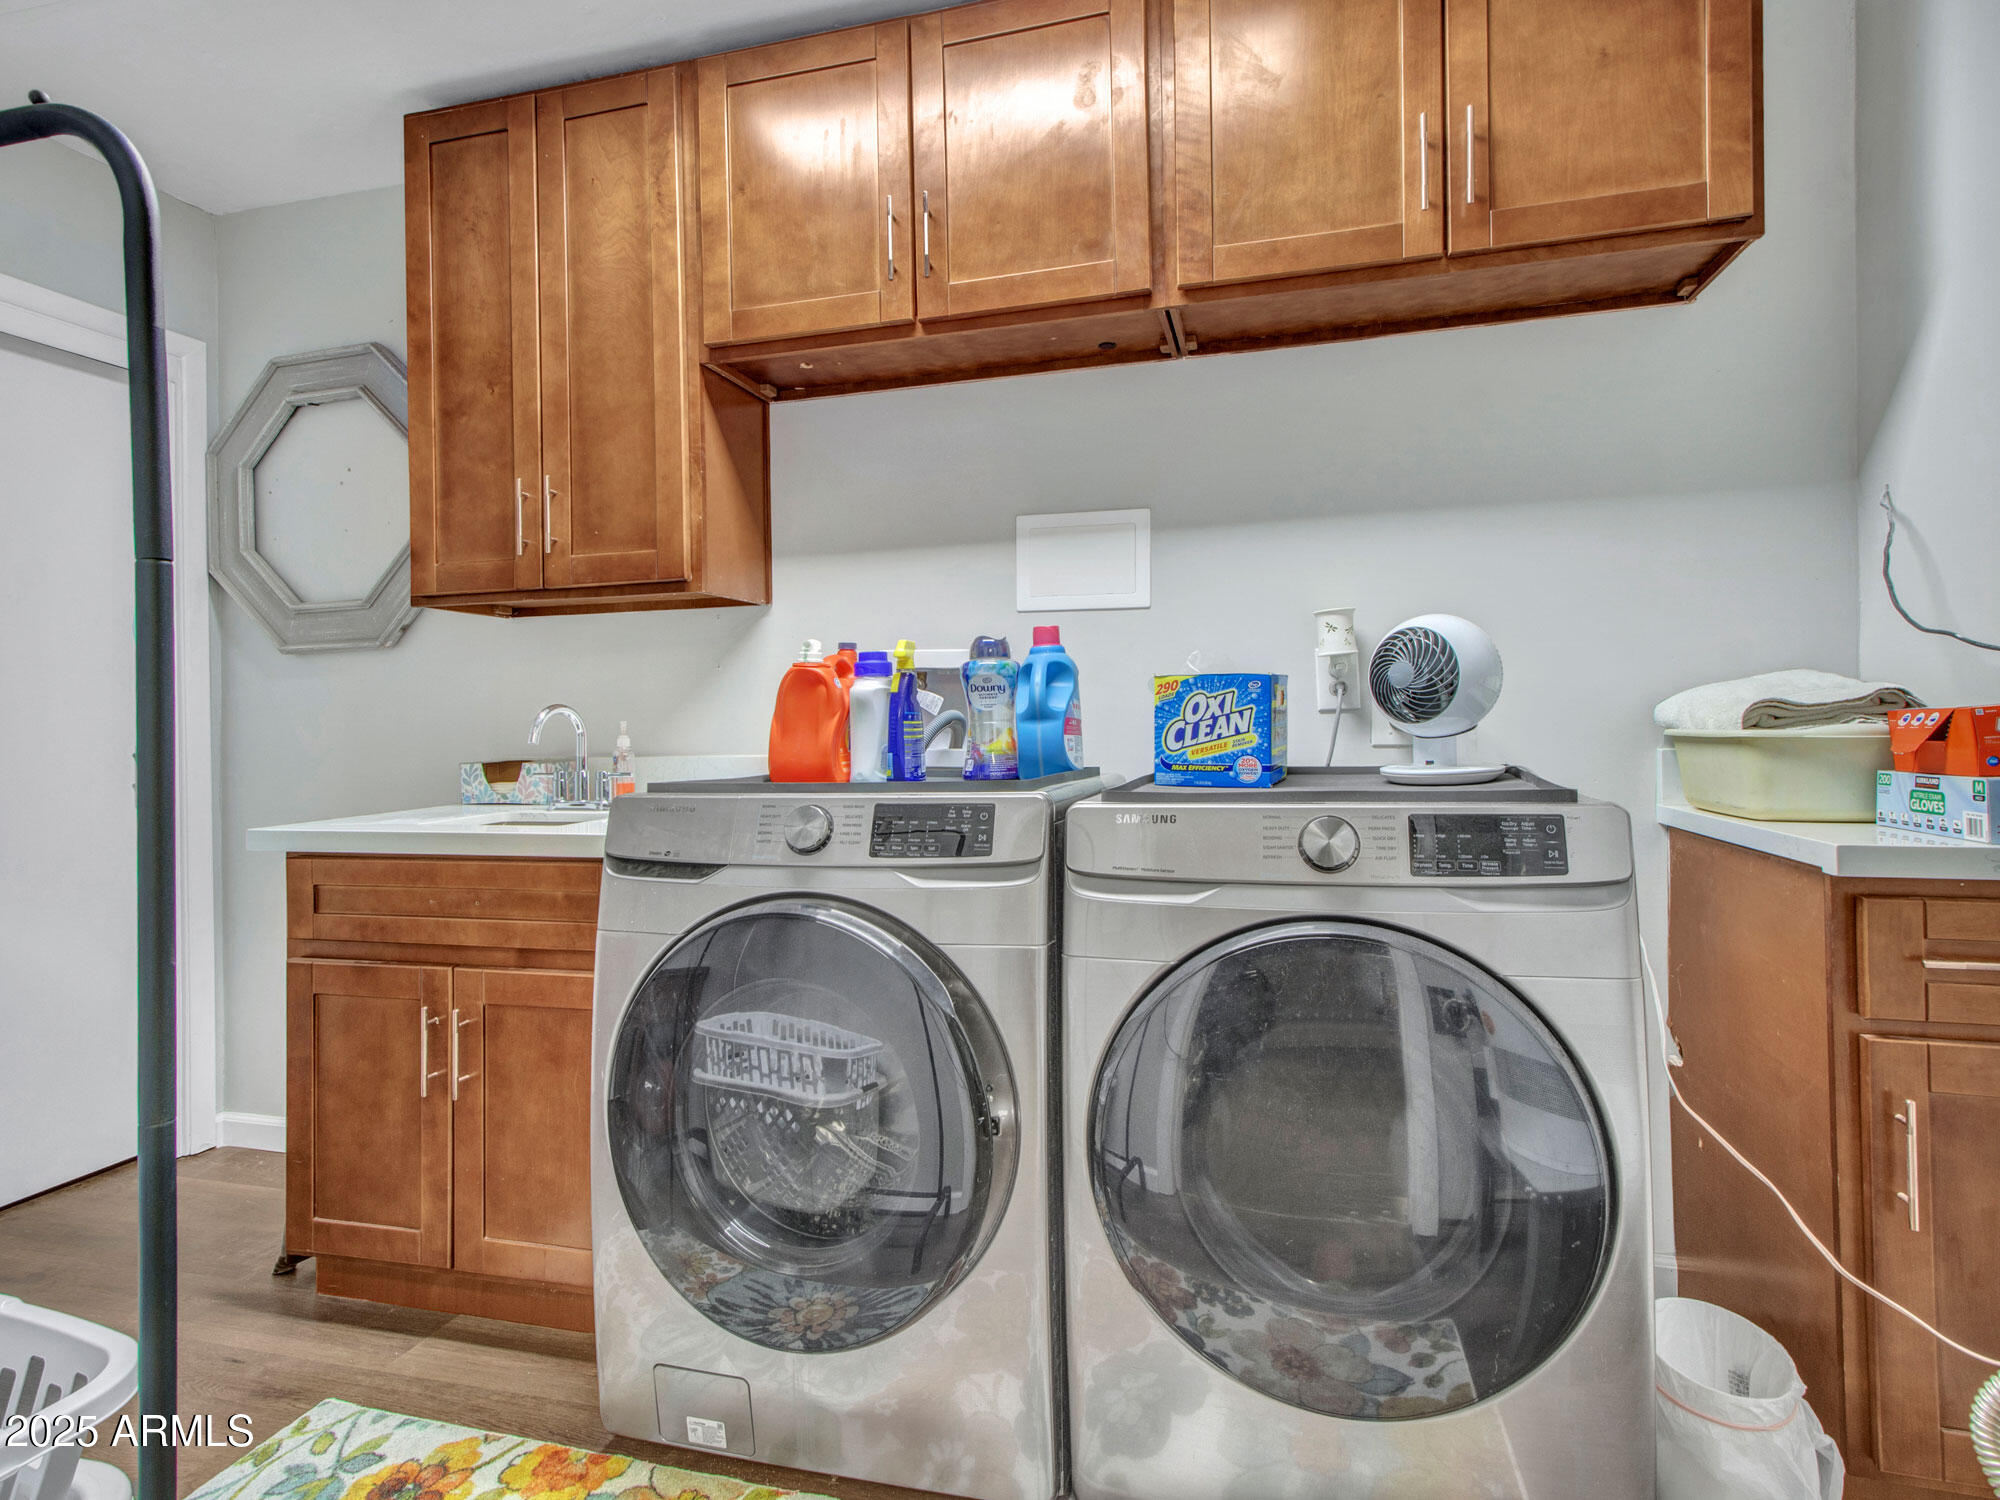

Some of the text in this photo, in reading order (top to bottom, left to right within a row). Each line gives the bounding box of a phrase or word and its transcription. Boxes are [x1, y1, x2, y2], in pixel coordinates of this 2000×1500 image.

[970, 683, 1006, 695] Downy
[1155, 680, 1178, 695] 290
[1183, 691, 1234, 723] OXI
[1165, 708, 1253, 752] CLEAN
[1191, 742, 1228, 756] VERSATILE
[1188, 764, 1226, 772] EFFICIENCY
[1879, 774, 1891, 785] 200
[1974, 781, 1984, 793] M
[1910, 798, 1945, 813] GLOVES
[1115, 813, 1177, 824] SAMUNG
